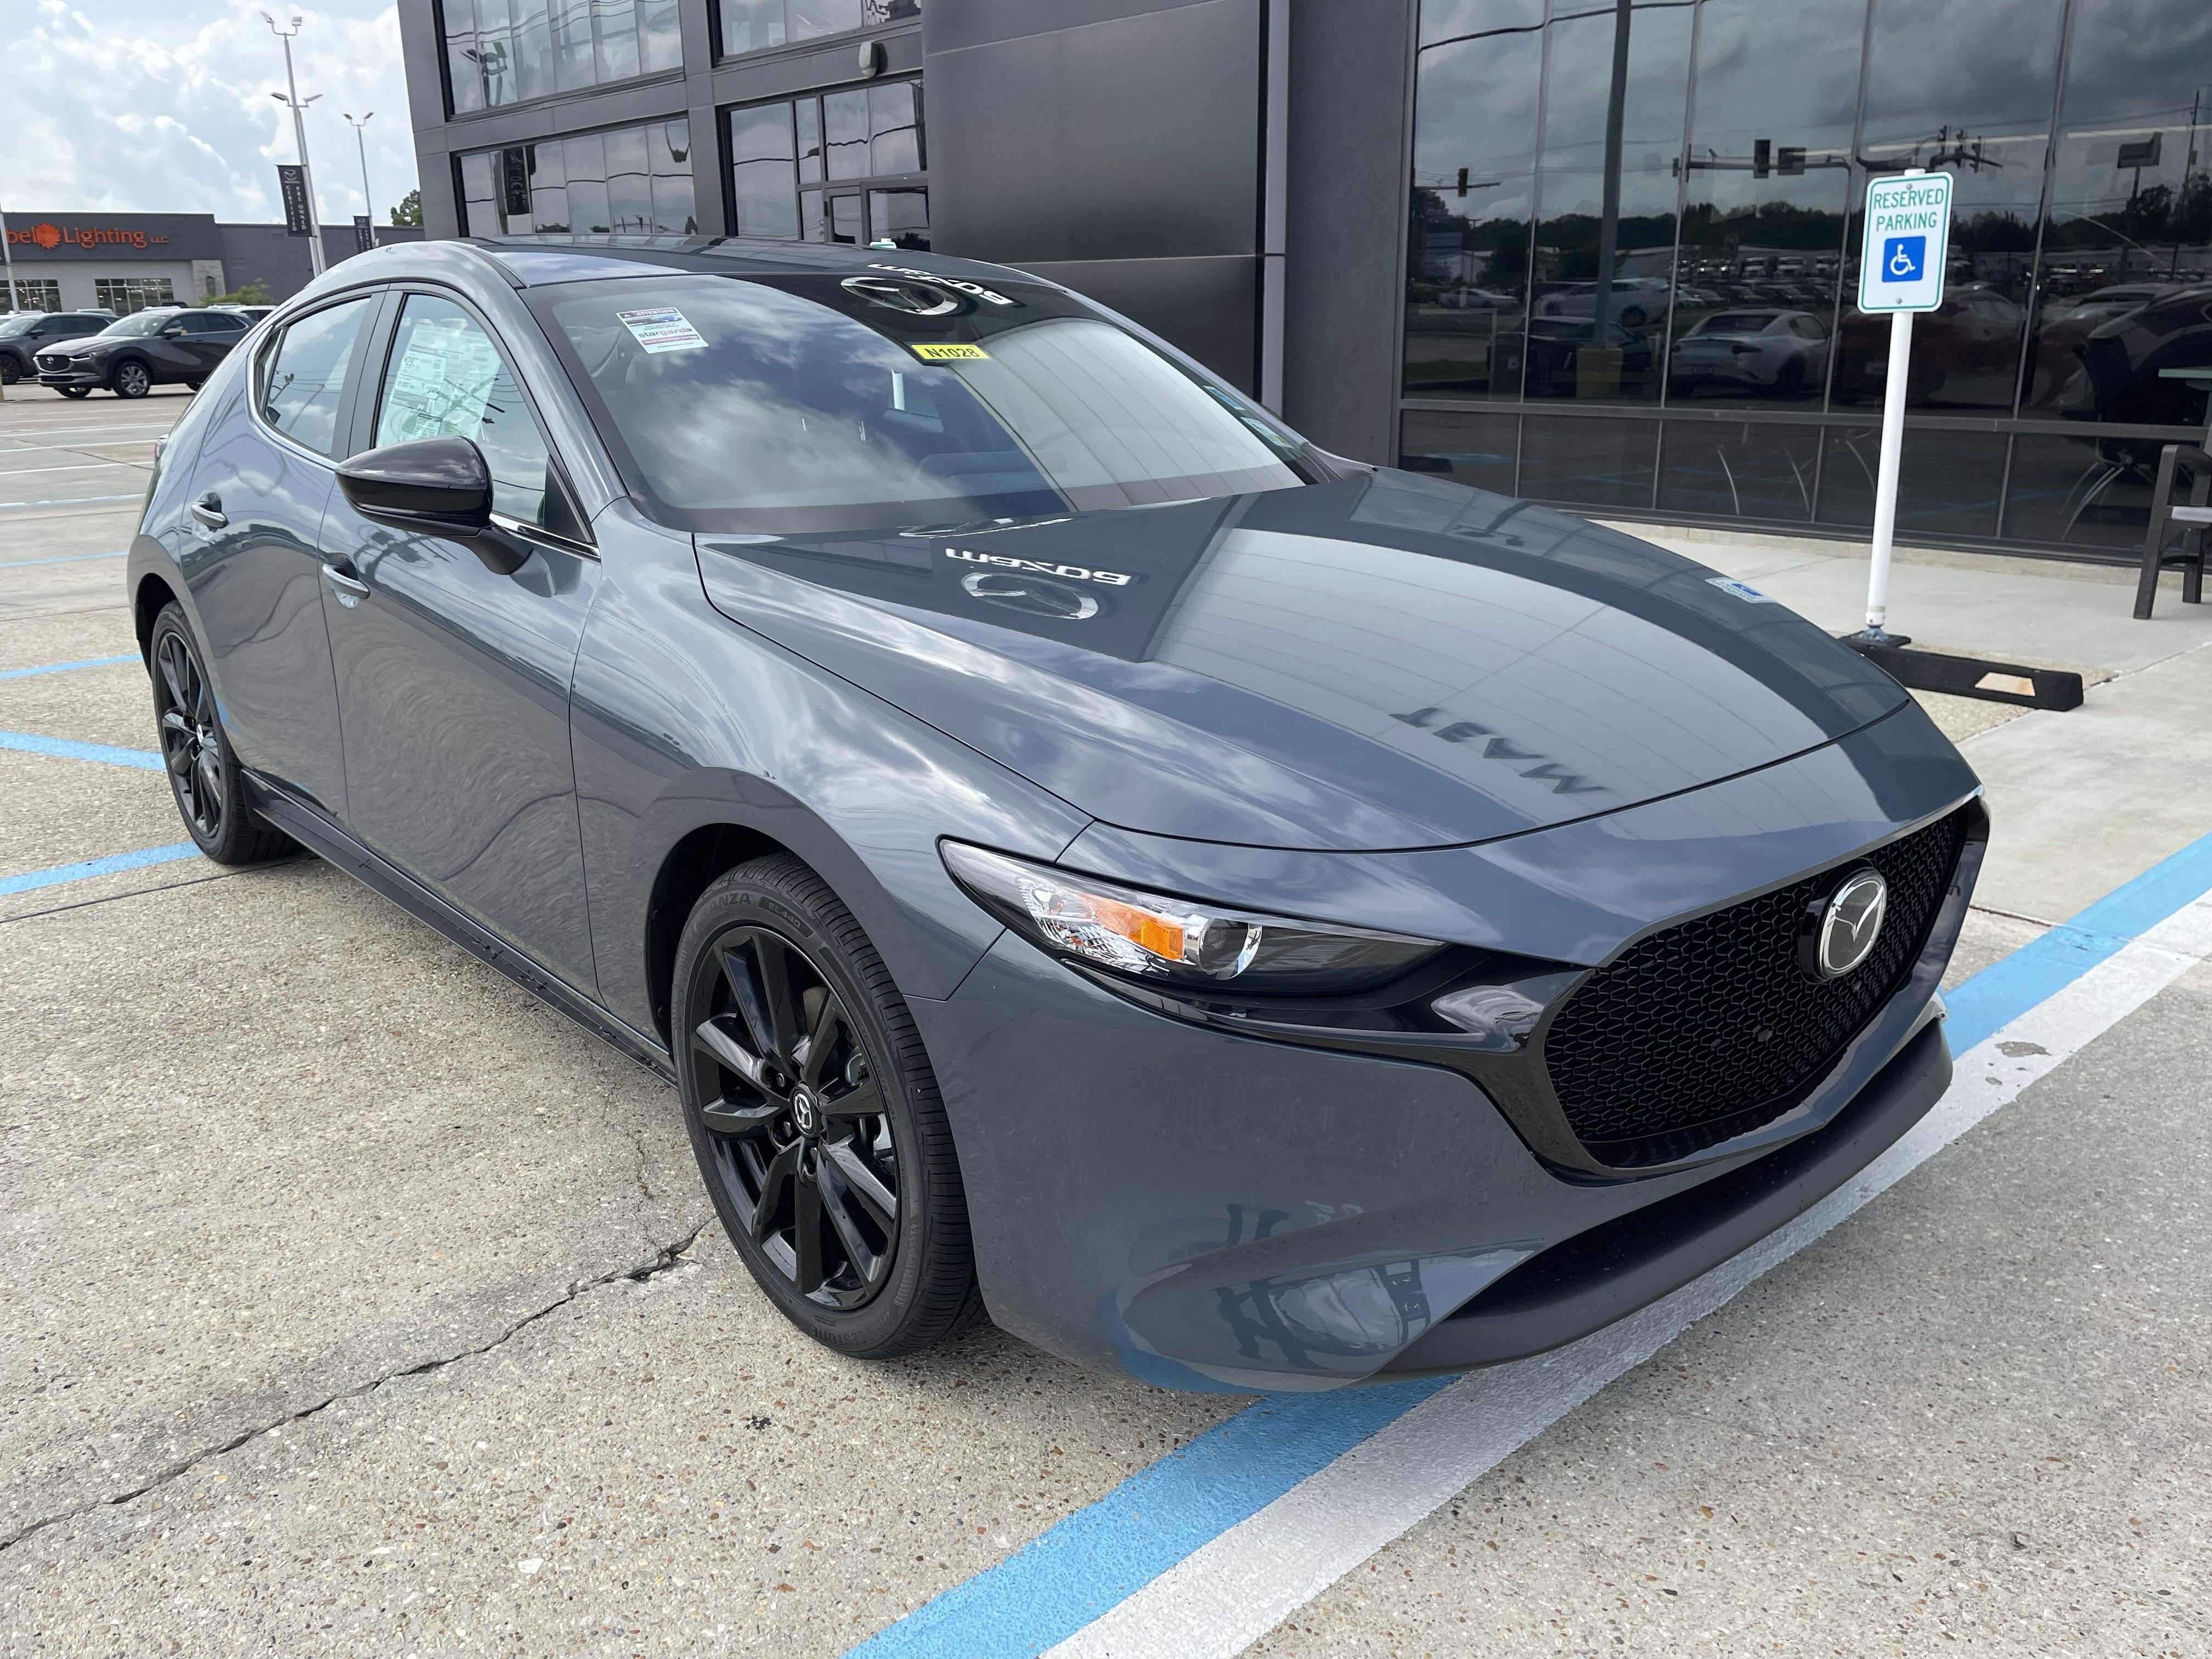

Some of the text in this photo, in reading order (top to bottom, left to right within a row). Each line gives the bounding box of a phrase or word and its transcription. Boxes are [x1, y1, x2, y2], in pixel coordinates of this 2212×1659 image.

[1874, 188, 1944, 210] RESERVED
[1876, 212, 1938, 232] PARKING
[62, 227, 148, 249] Lighting
[150, 235, 169, 244] LLC
[924, 348, 980, 358] N1028
[768, 902, 802, 929] EL440
